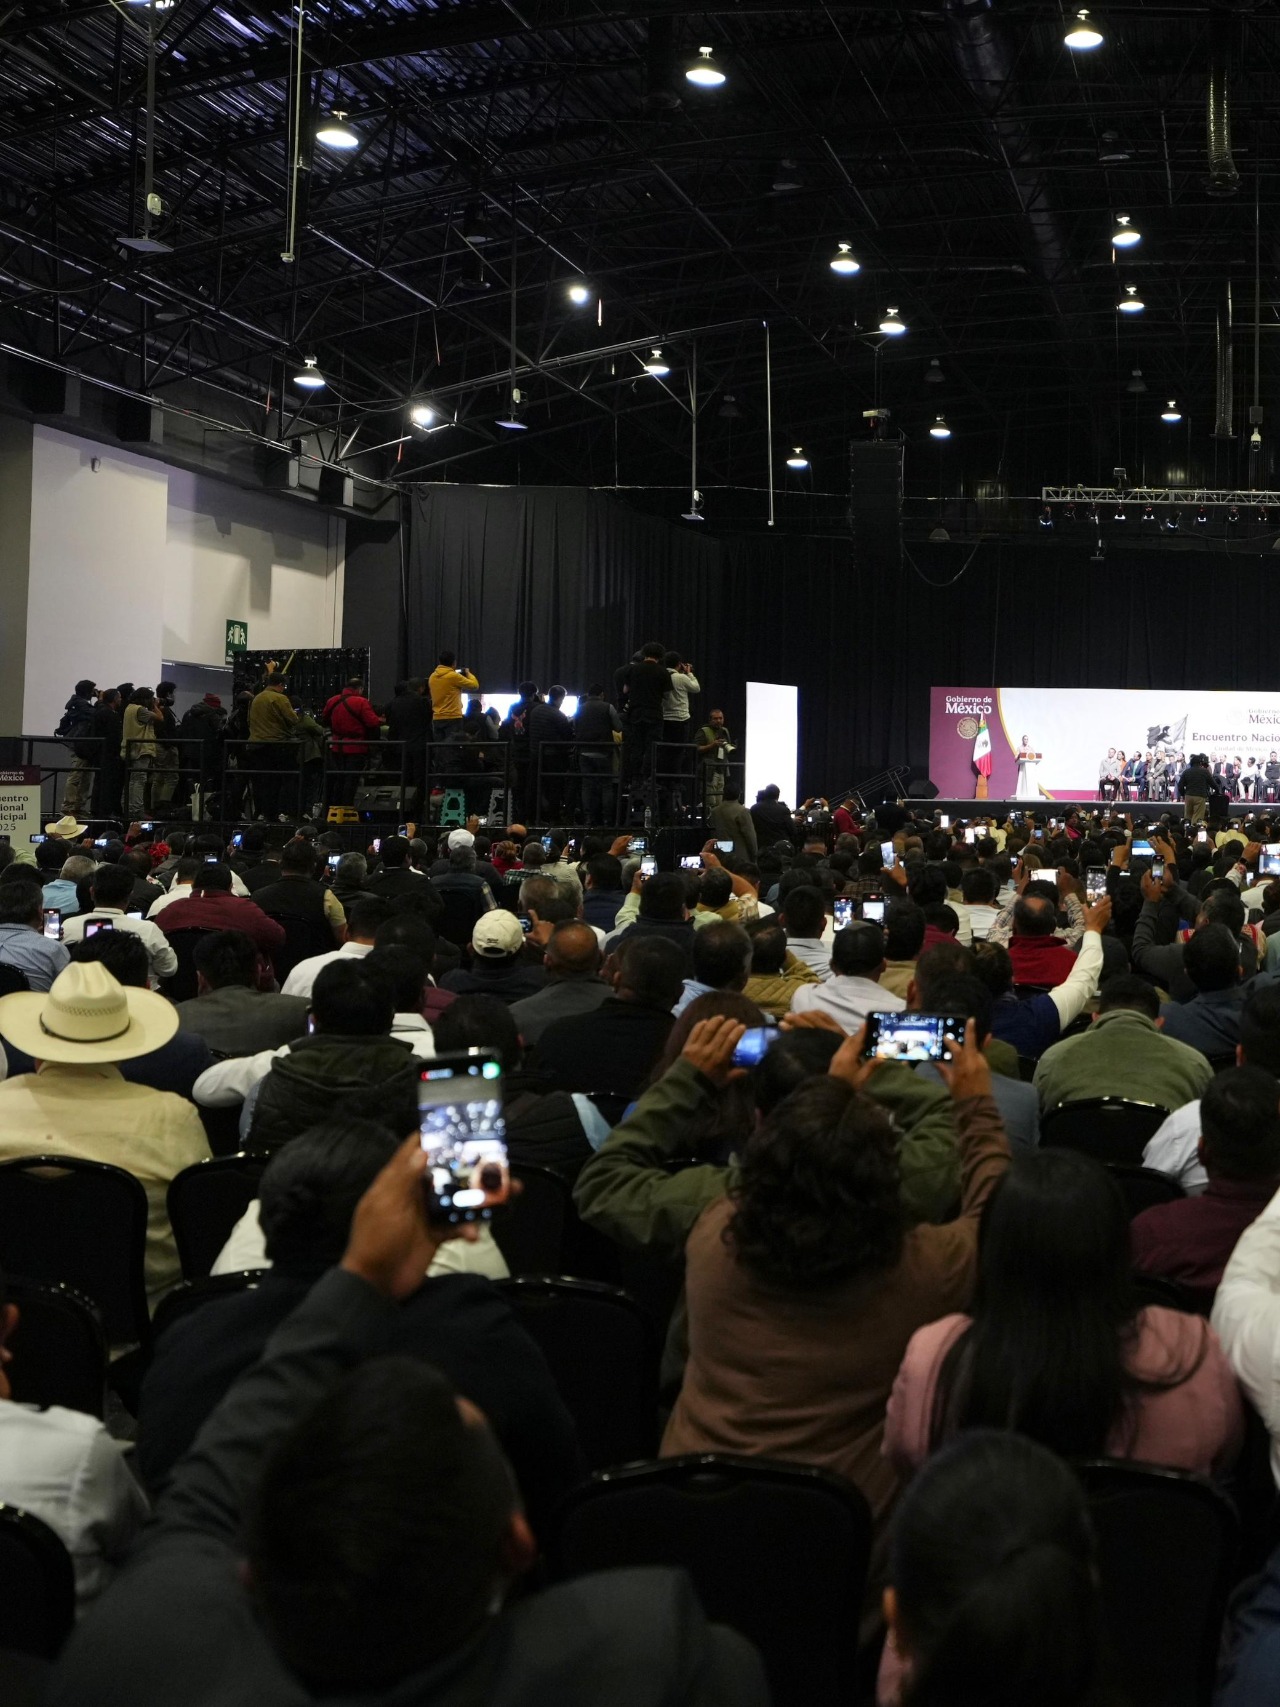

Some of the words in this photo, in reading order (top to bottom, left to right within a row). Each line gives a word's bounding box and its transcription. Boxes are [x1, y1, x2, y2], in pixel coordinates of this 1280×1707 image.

[945, 703, 992, 714] México
[1192, 732, 1248, 742] Encuentro
[0, 803, 24, 811] ional
[0, 812, 27, 822] icipal
